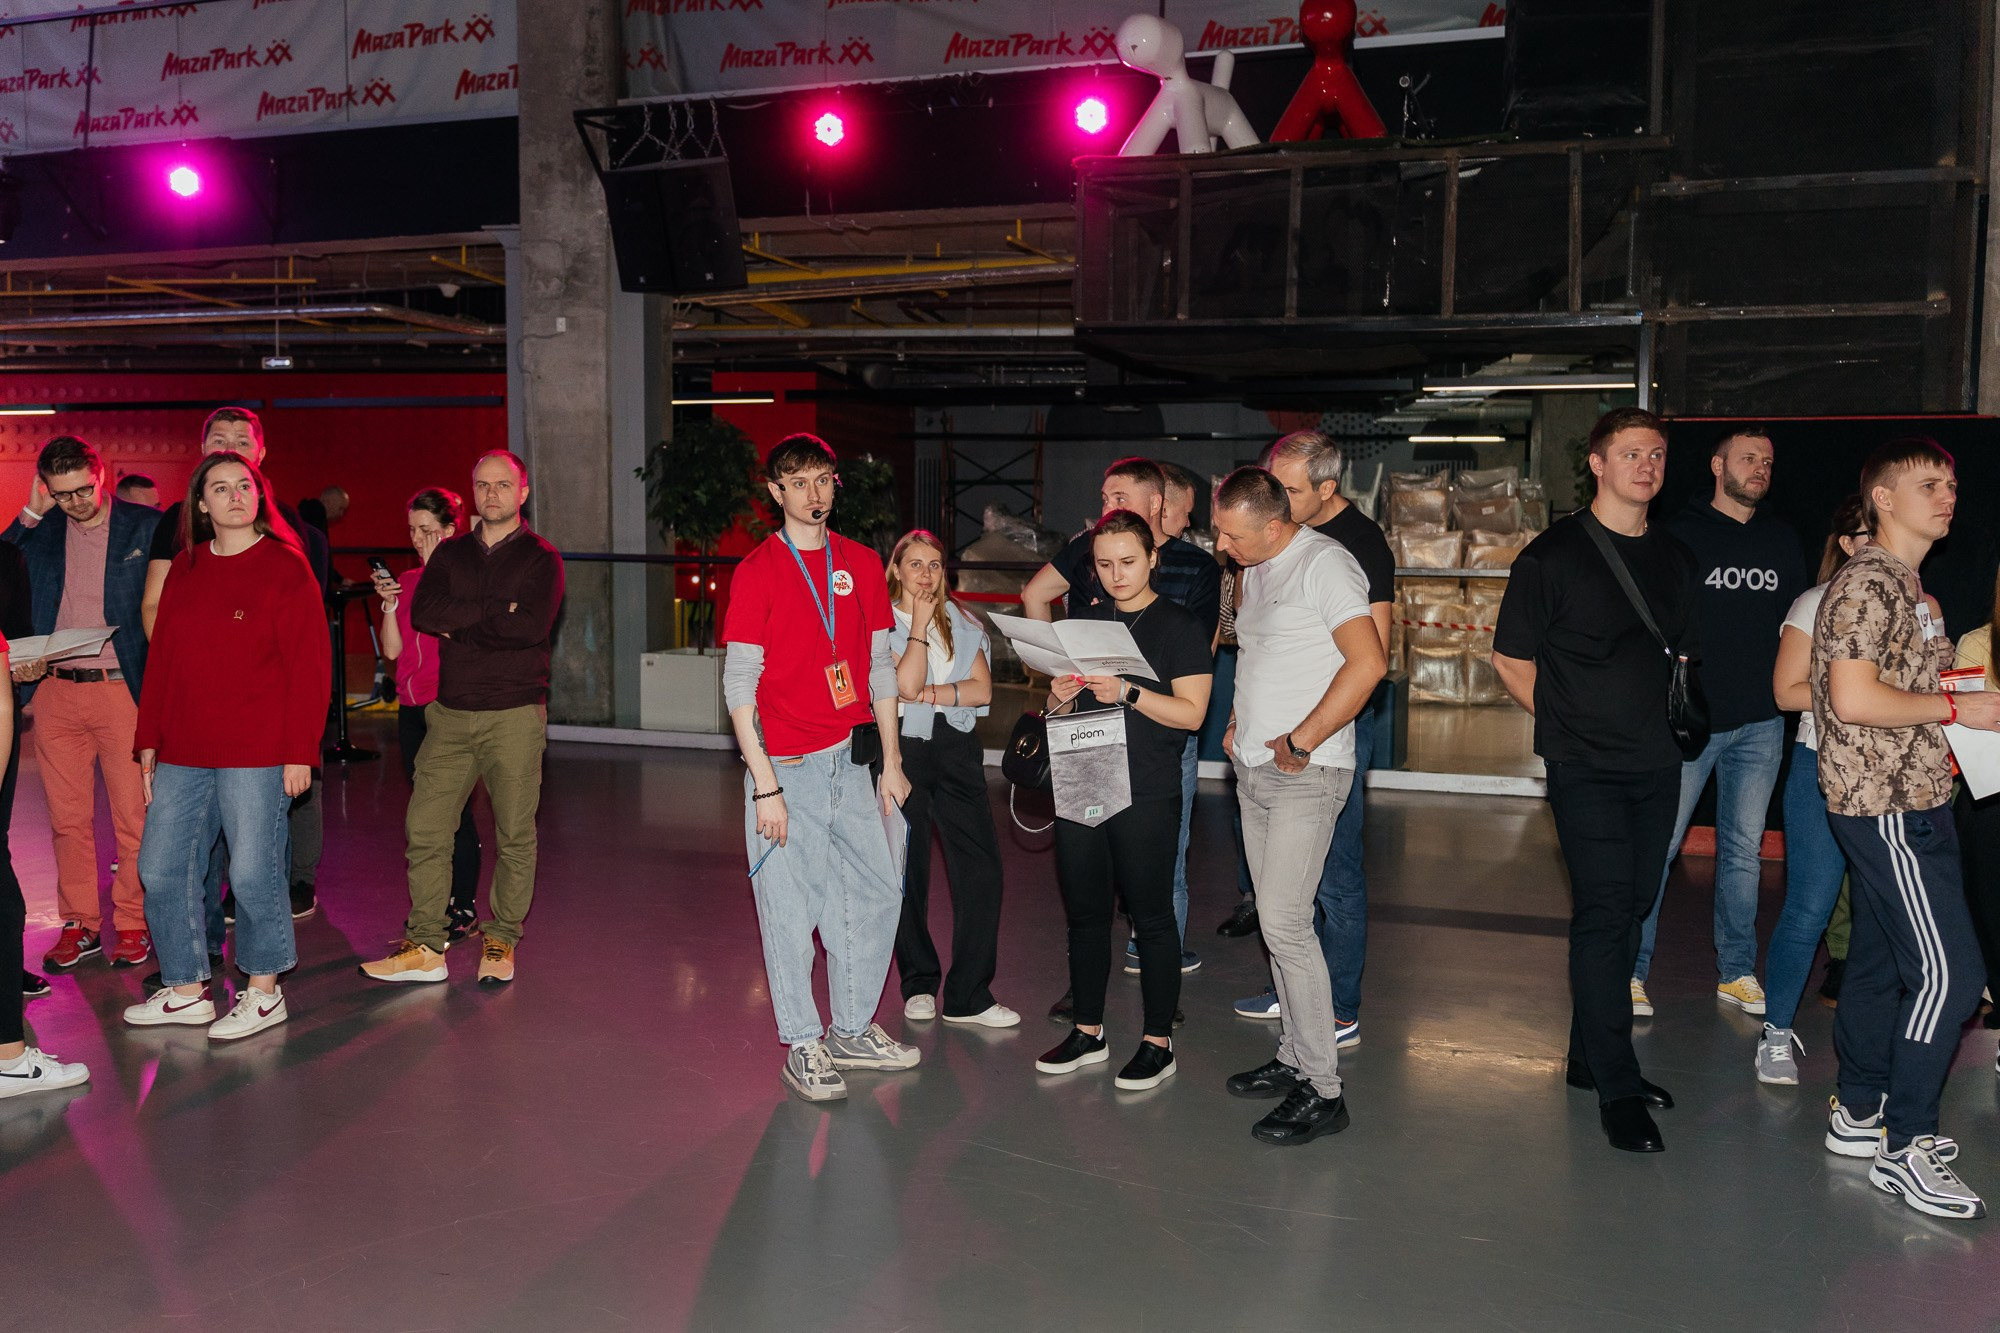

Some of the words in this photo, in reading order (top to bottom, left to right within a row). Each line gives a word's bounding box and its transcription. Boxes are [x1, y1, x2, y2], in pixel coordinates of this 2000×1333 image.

[353, 19, 459, 59] MazaPark
[944, 31, 1075, 64] MazaPark
[161, 45, 261, 81] MazaPark
[720, 41, 834, 72] MazaPark
[0, 67, 72, 93] azaPark
[257, 84, 358, 121] MazaPark
[1704, 567, 1778, 591] 40'09
[1071, 725, 1104, 748] ploom
